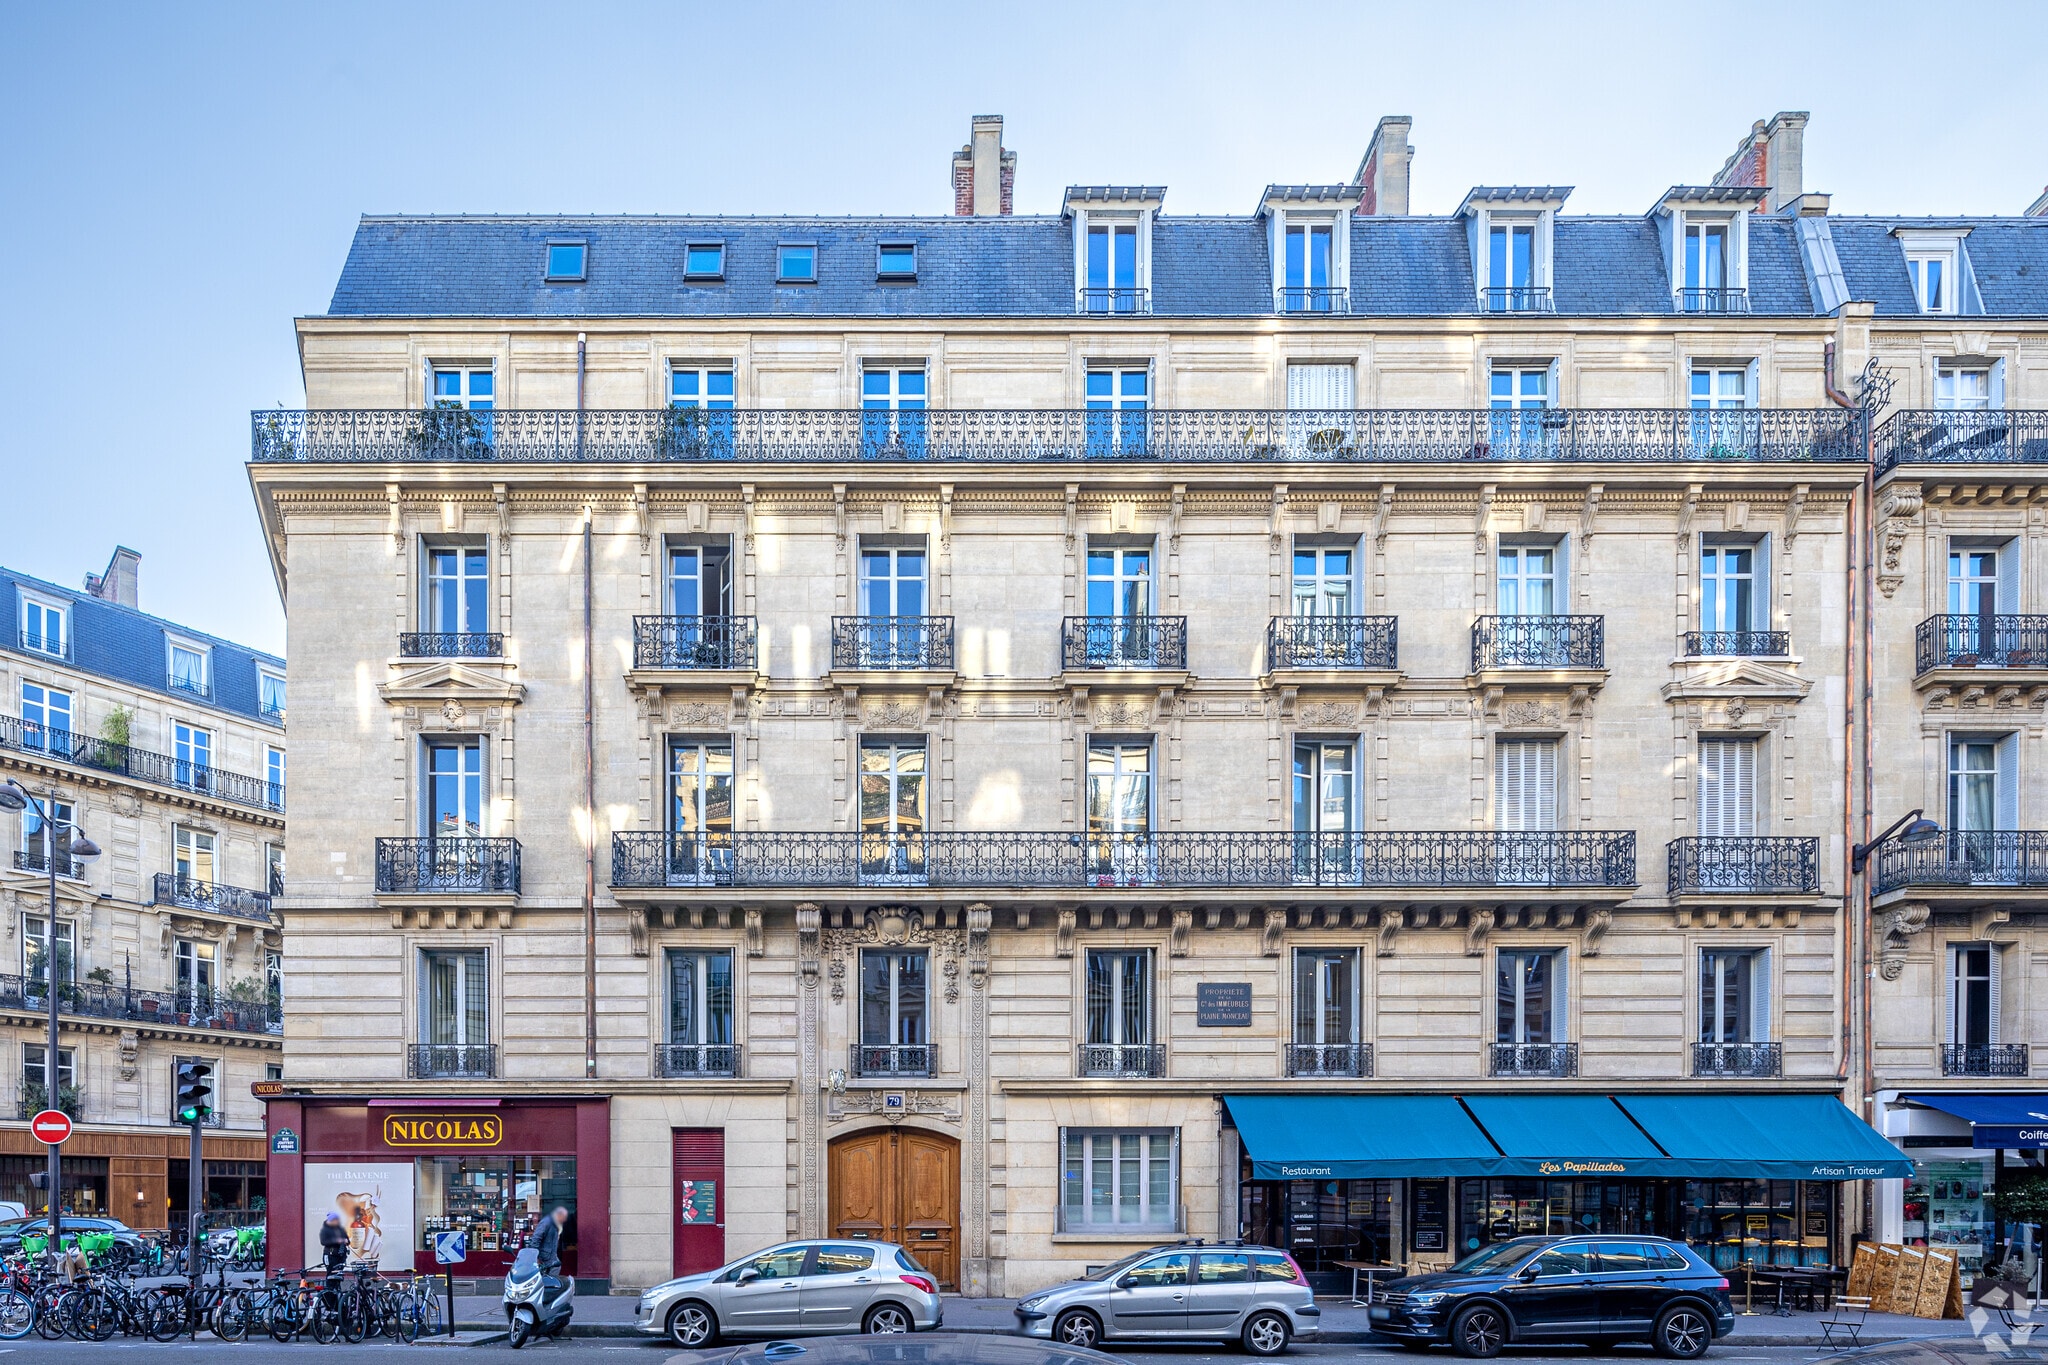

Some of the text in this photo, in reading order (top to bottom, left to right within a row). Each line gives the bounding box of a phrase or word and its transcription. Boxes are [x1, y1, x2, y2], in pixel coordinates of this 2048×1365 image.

[256, 1085, 281, 1093] NICOLAS
[888, 1097, 900, 1106] 79
[391, 1121, 495, 1140] NICOLAS
[1282, 1166, 1331, 1176] Restaurant
[1539, 1161, 1626, 1175] Les Papillades
[1812, 1166, 1885, 1175] Artisan Traiteur
[344, 1171, 389, 1180] BALVENIE
